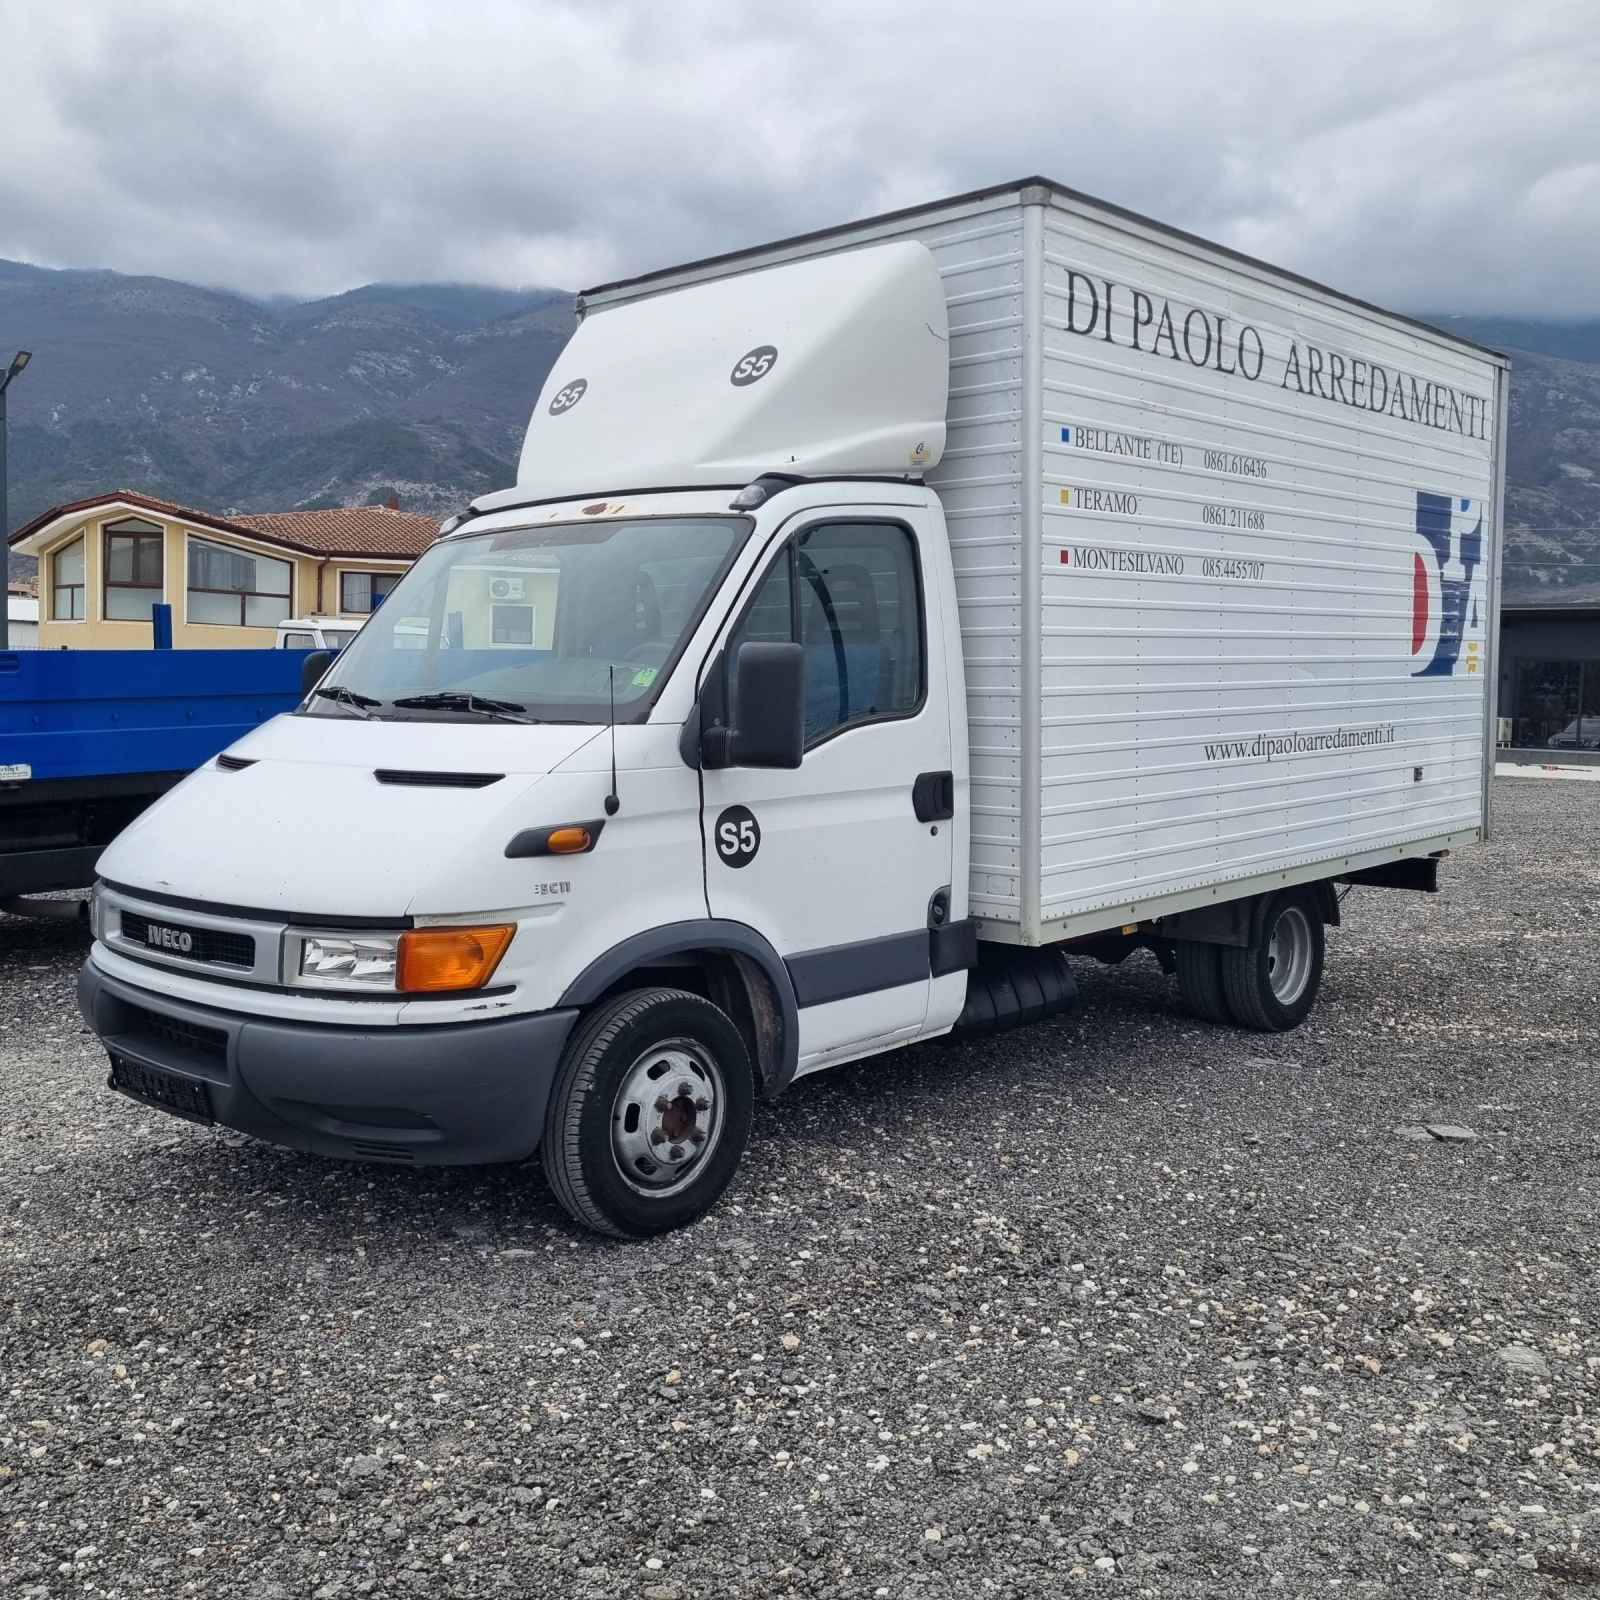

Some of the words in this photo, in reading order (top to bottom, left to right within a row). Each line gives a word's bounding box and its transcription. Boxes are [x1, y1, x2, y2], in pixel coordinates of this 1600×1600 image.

[734, 354, 774, 379] S5
[1063, 268, 1116, 343] DI
[1129, 289, 1264, 381] PAOLO
[1280, 339, 1488, 440] ARREDAMENTI
[552, 386, 584, 409] S5
[1075, 427, 1152, 459] BELLANTE
[1157, 442, 1184, 470] (TE)
[1204, 450, 1267, 479] 0861.616436
[1074, 488, 1138, 515] TERAMO
[1202, 505, 1265, 530] 0861.211688
[1073, 548, 1185, 575] MONTESILVANO
[1202, 558, 1265, 580] 085.4455707
[1204, 723, 1395, 761] www.dipaoloarredamenti.it
[720, 820, 756, 856] S5
[534, 881, 571, 895] 35C11
[148, 924, 192, 952] IVECO
